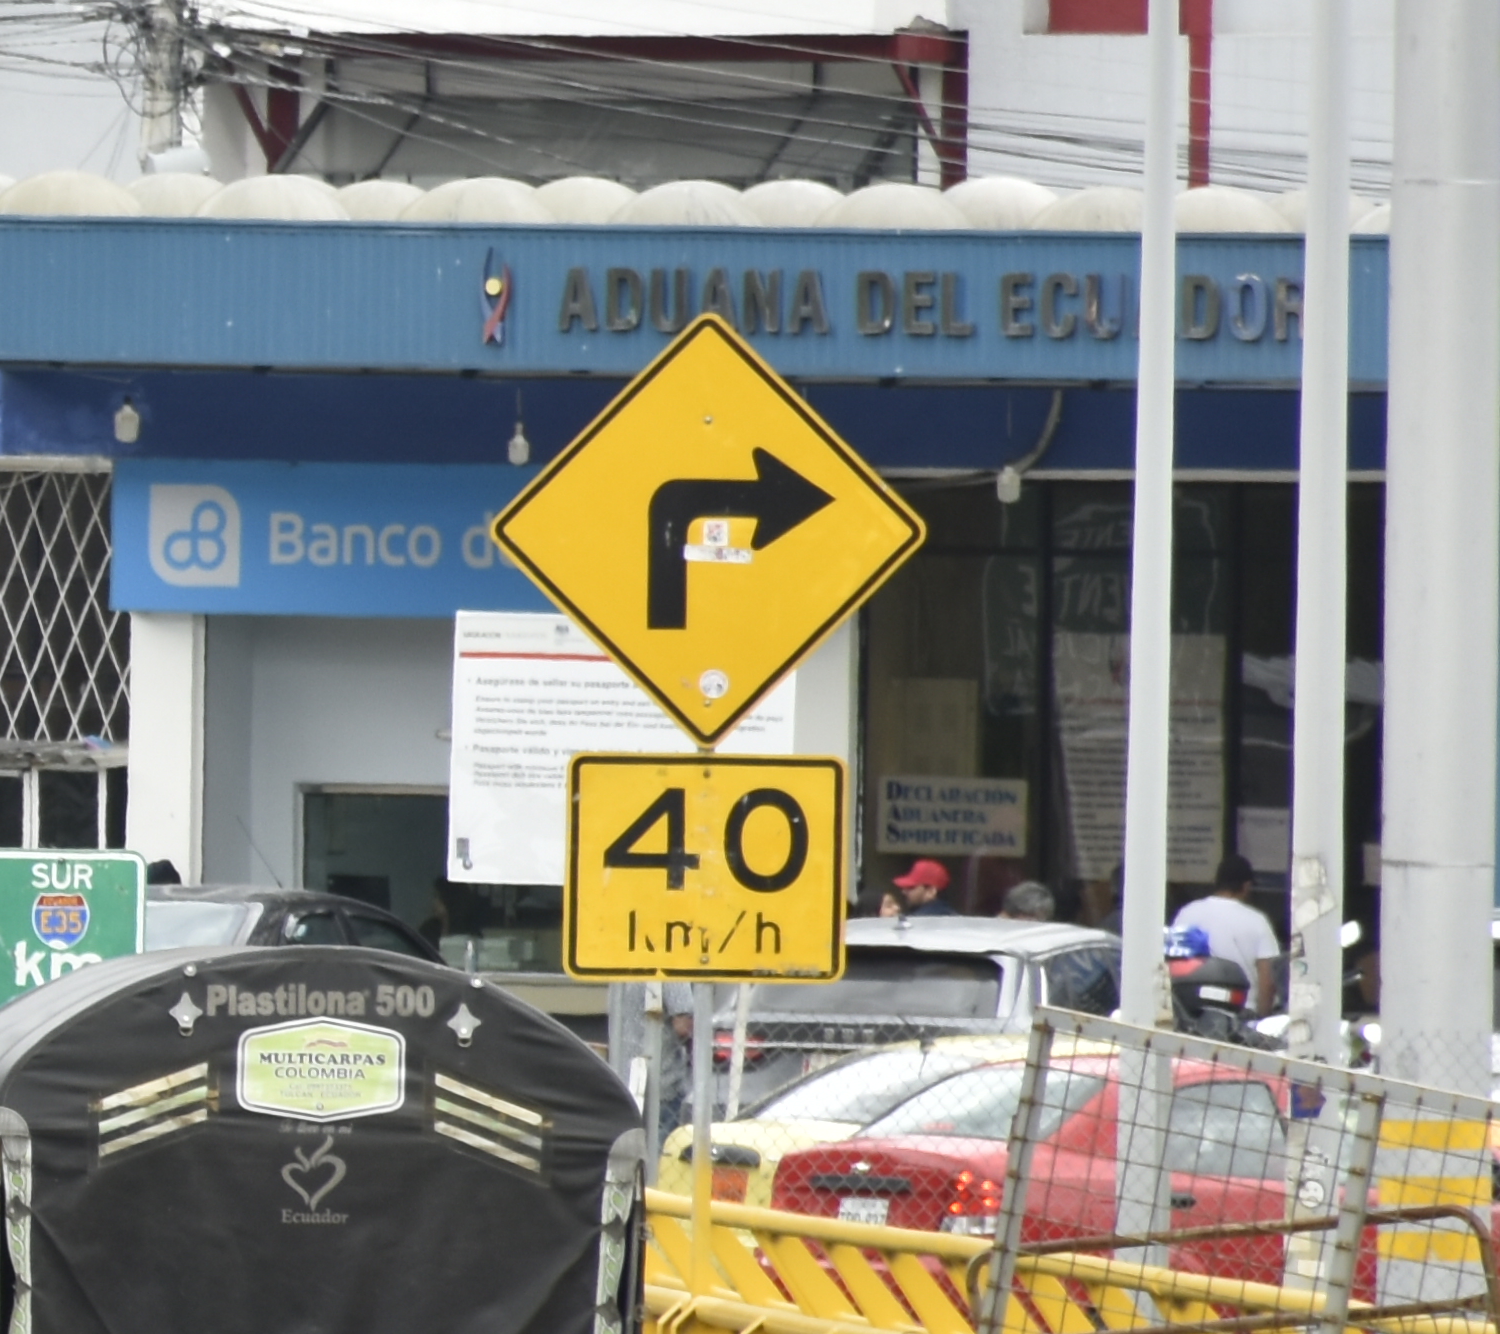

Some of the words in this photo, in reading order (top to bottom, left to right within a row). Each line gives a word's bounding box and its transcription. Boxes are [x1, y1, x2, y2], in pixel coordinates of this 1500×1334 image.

[557, 267, 830, 335] ADUANA
[856, 270, 974, 338] DEL
[999, 273, 1305, 342] ECUDOR
[268, 512, 443, 568] Banco
[602, 787, 810, 894] 40
[31, 862, 94, 890] SUR
[40, 910, 83, 934] E35
[375, 984, 437, 1019] 500
[259, 1052, 387, 1066] MULTICARPAS
[274, 1066, 367, 1080] COLOMBIA
[281, 1207, 349, 1224] Ecuador
